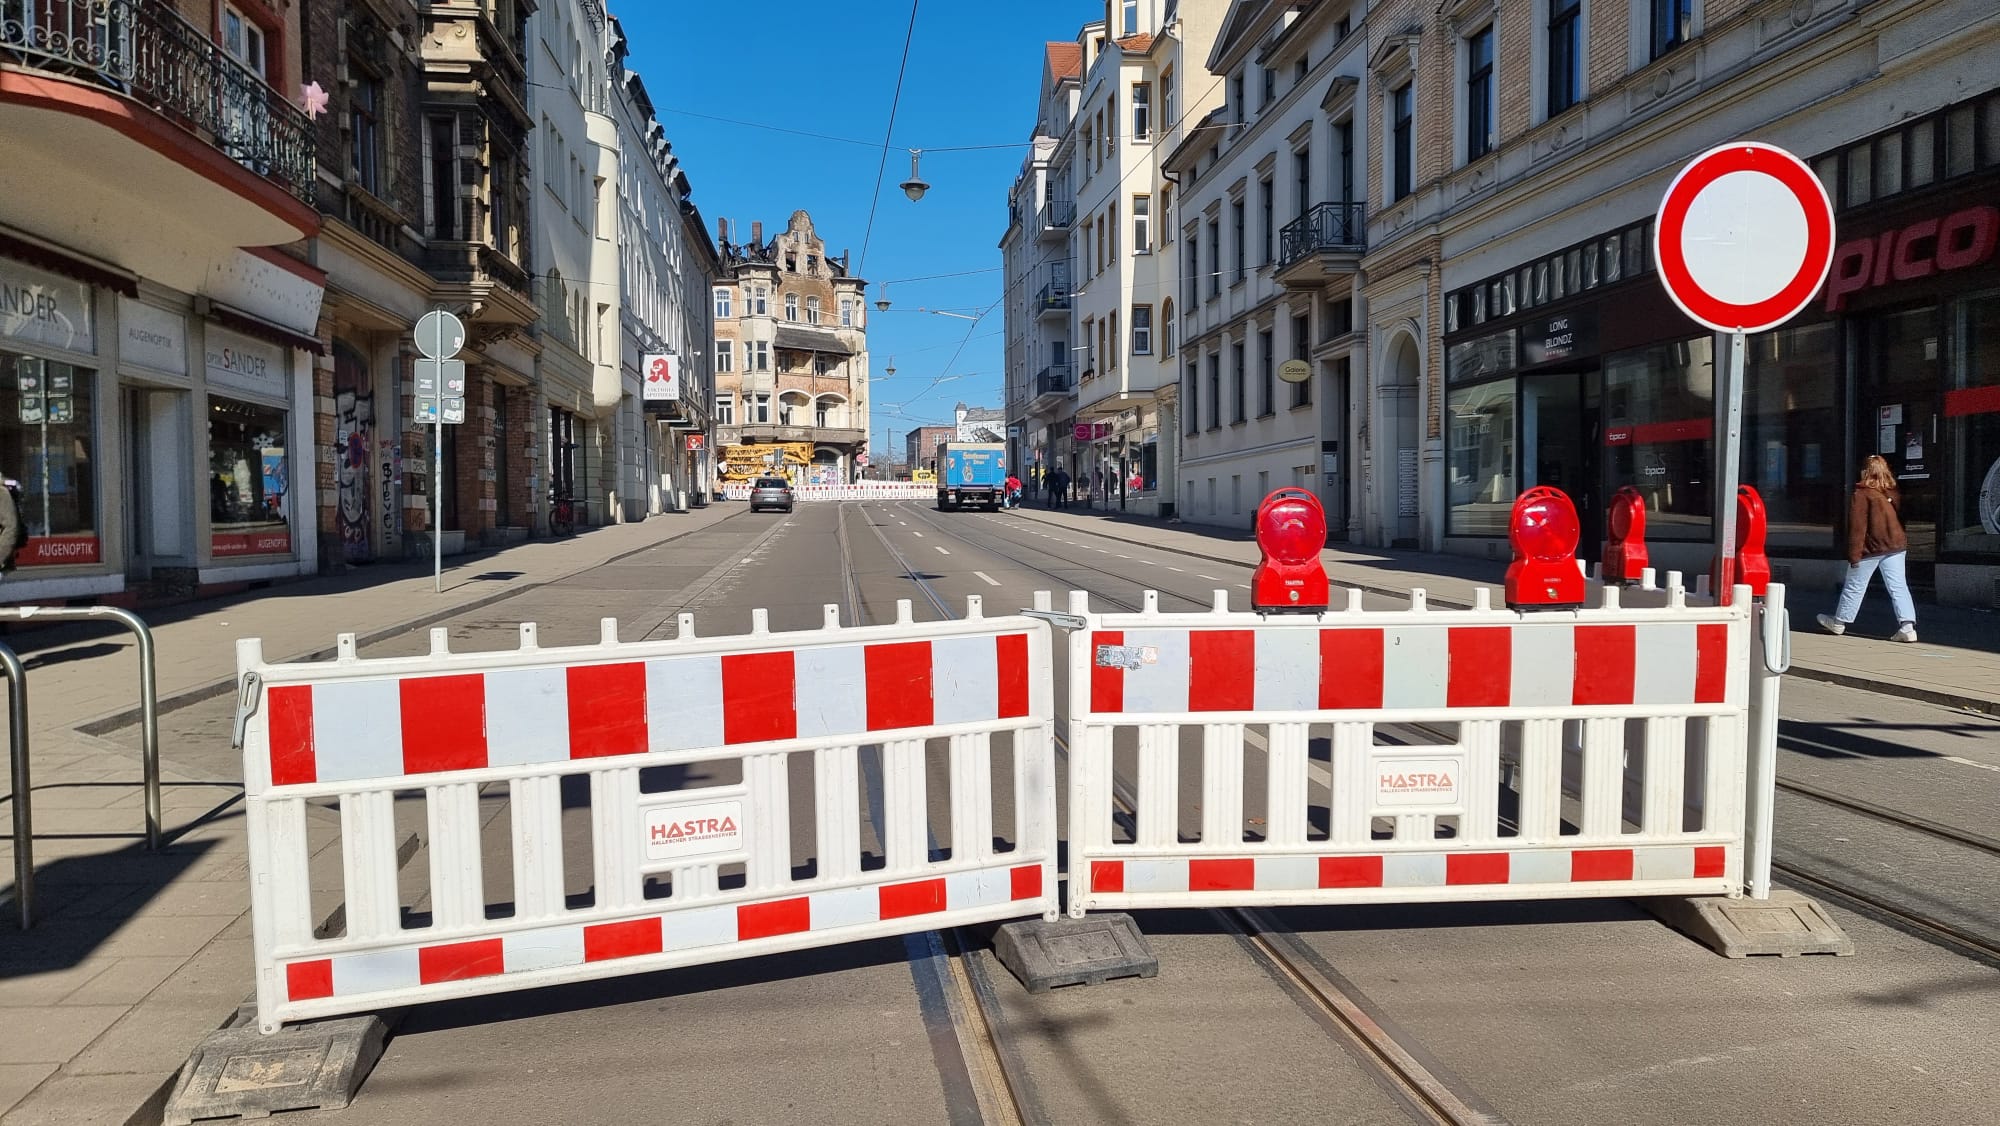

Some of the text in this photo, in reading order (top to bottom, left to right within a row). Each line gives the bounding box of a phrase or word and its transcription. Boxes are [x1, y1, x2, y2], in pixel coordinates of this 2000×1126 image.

[1818, 206, 2000, 312] pico
[0, 284, 58, 324] NDER
[1549, 319, 1568, 332] LONG
[129, 328, 172, 348] AUGENOPTIK
[1545, 333, 1572, 349] BLONDZ
[224, 348, 267, 379] SANDER
[38, 543, 93, 557] AUGENOPTIK
[1380, 773, 1453, 787] HASTRA
[651, 816, 737, 840] HASTRA
